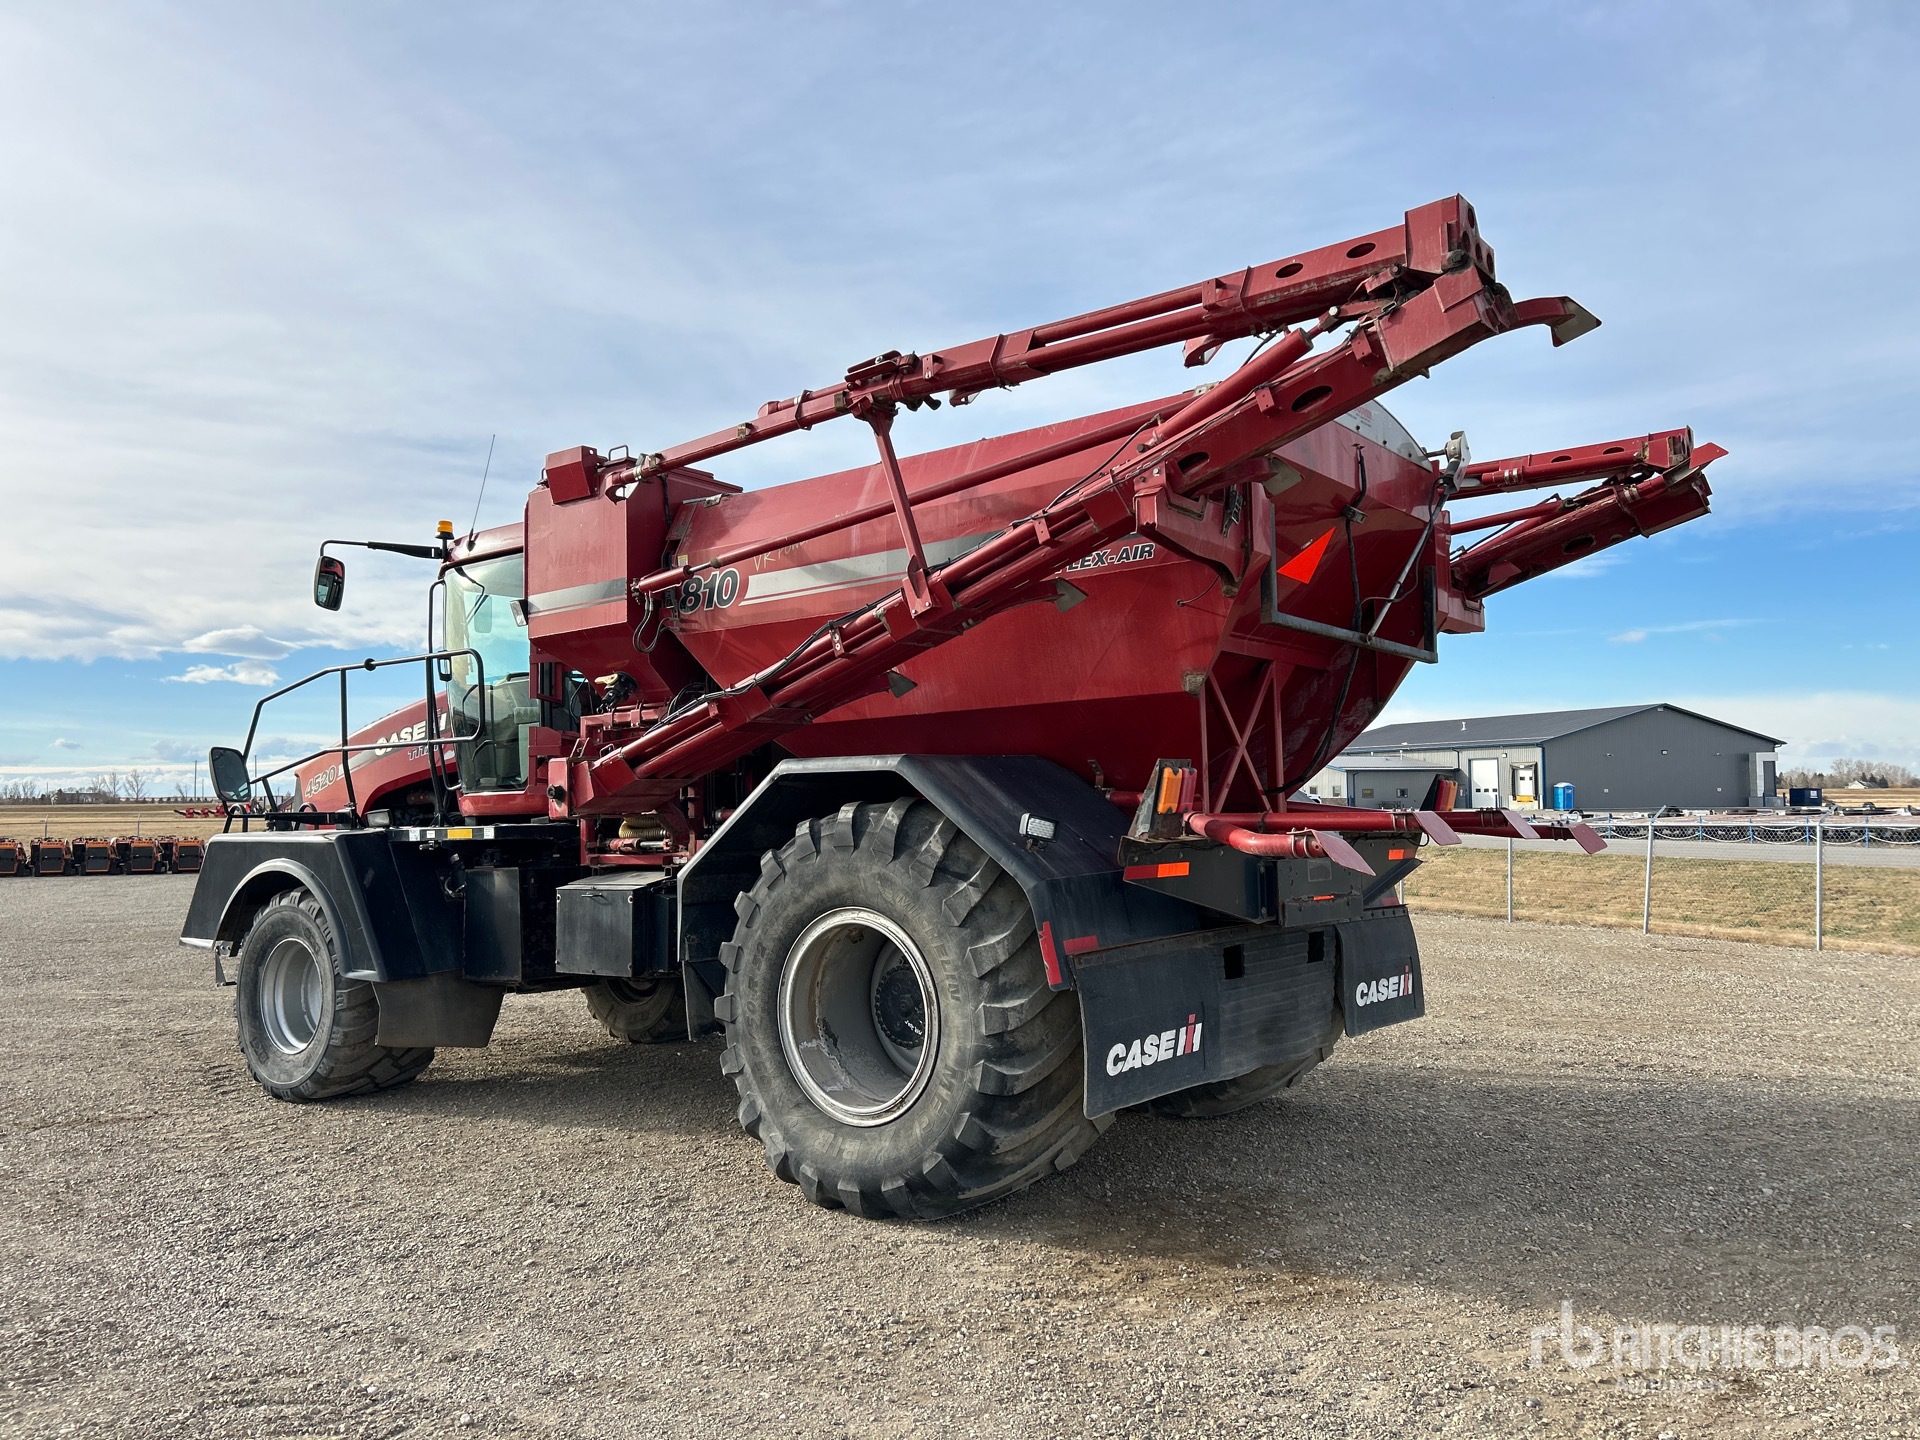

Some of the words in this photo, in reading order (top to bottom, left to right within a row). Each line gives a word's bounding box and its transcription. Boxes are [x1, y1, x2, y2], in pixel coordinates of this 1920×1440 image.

[1055, 543, 1155, 574] LEX-AIR
[679, 567, 740, 615] 810
[305, 765, 336, 798] 4520
